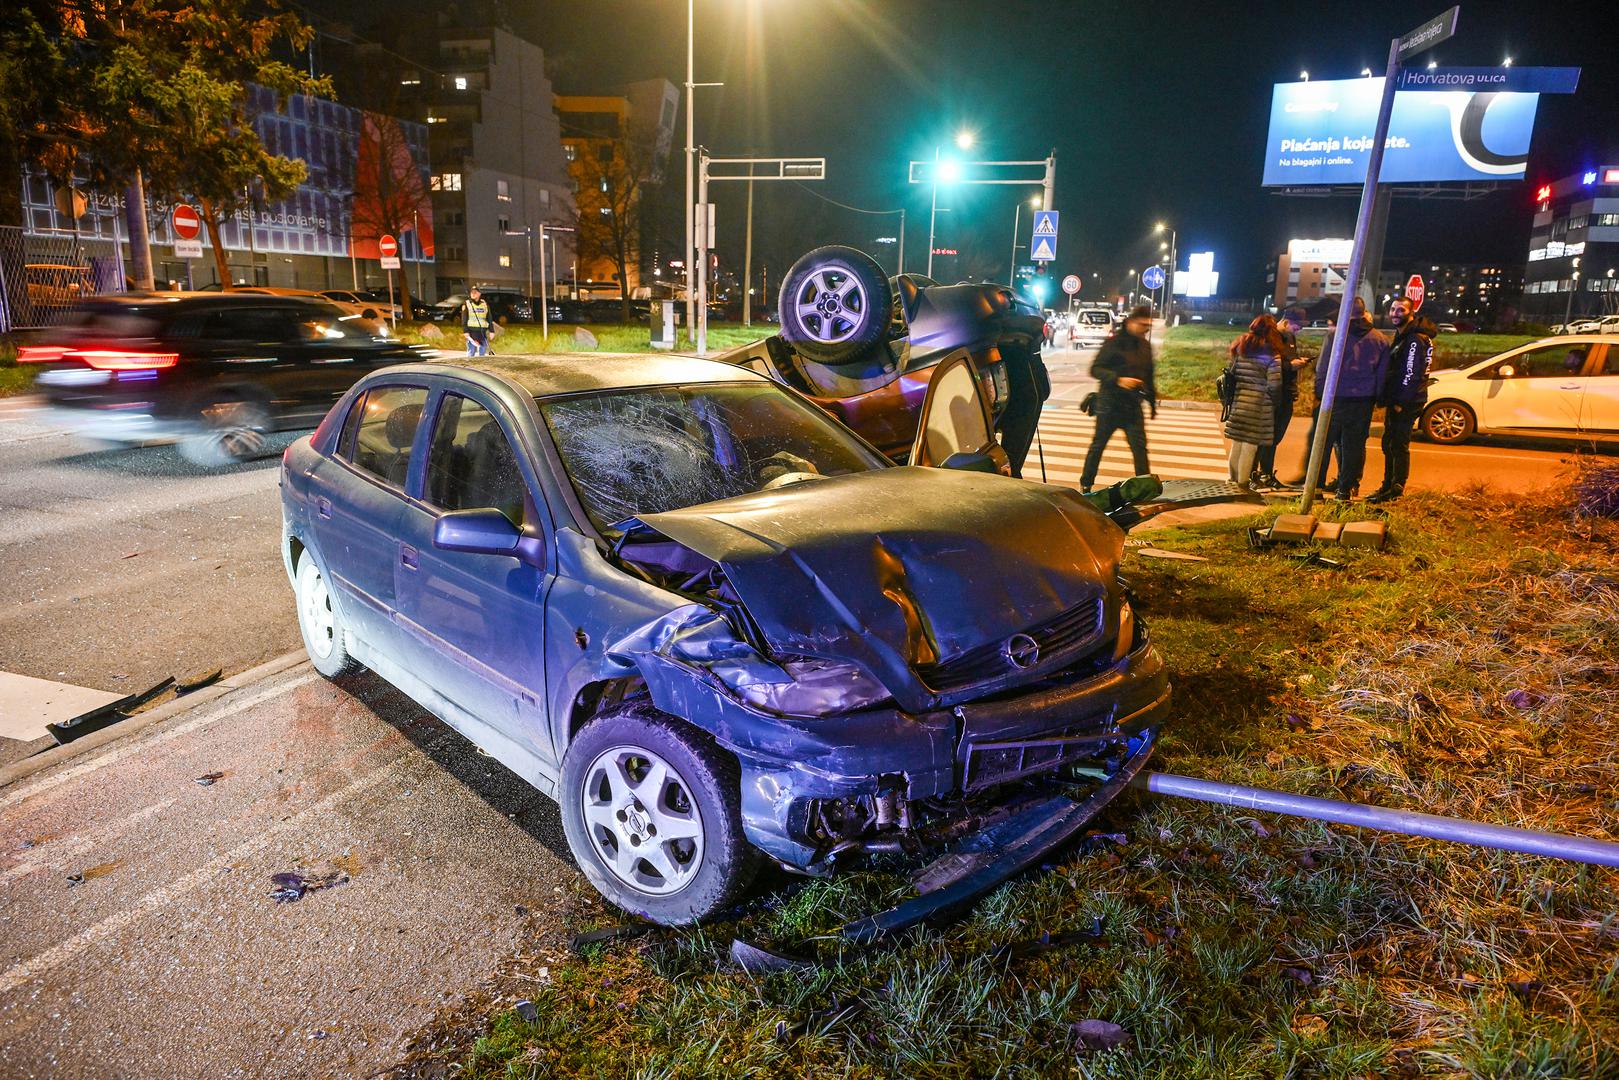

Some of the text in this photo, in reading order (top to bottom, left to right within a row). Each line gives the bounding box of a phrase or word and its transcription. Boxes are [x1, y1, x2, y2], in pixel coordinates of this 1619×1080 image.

[1407, 72, 1506, 84] Horvatova ULICA
[1280, 136, 1411, 153] Plaćanja koja ete.
[1279, 158, 1291, 167] Na
[1292, 157, 1322, 168] blagajni
[1327, 156, 1354, 166] online.
[1066, 279, 1077, 289] 60
[1408, 286, 1423, 300] STOP
